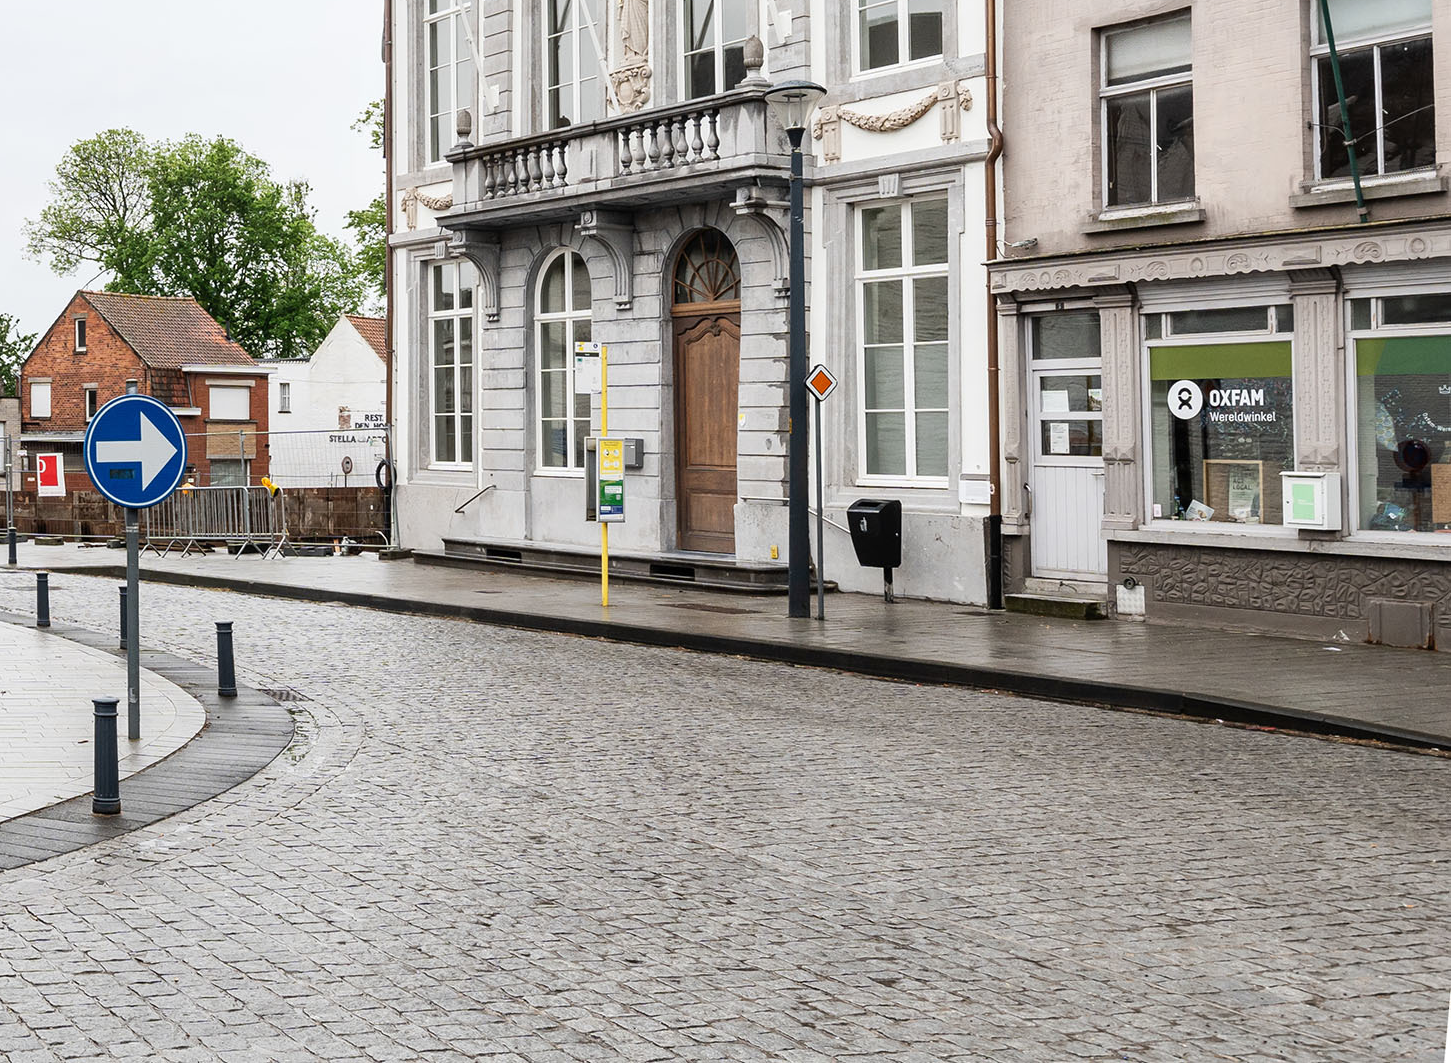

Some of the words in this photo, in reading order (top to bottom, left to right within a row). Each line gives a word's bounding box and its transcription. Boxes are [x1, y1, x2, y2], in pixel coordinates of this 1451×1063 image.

[1209, 389, 1264, 406] OXFAM
[1210, 411, 1277, 422] Wereldwinkel
[329, 435, 356, 443] STELLA
